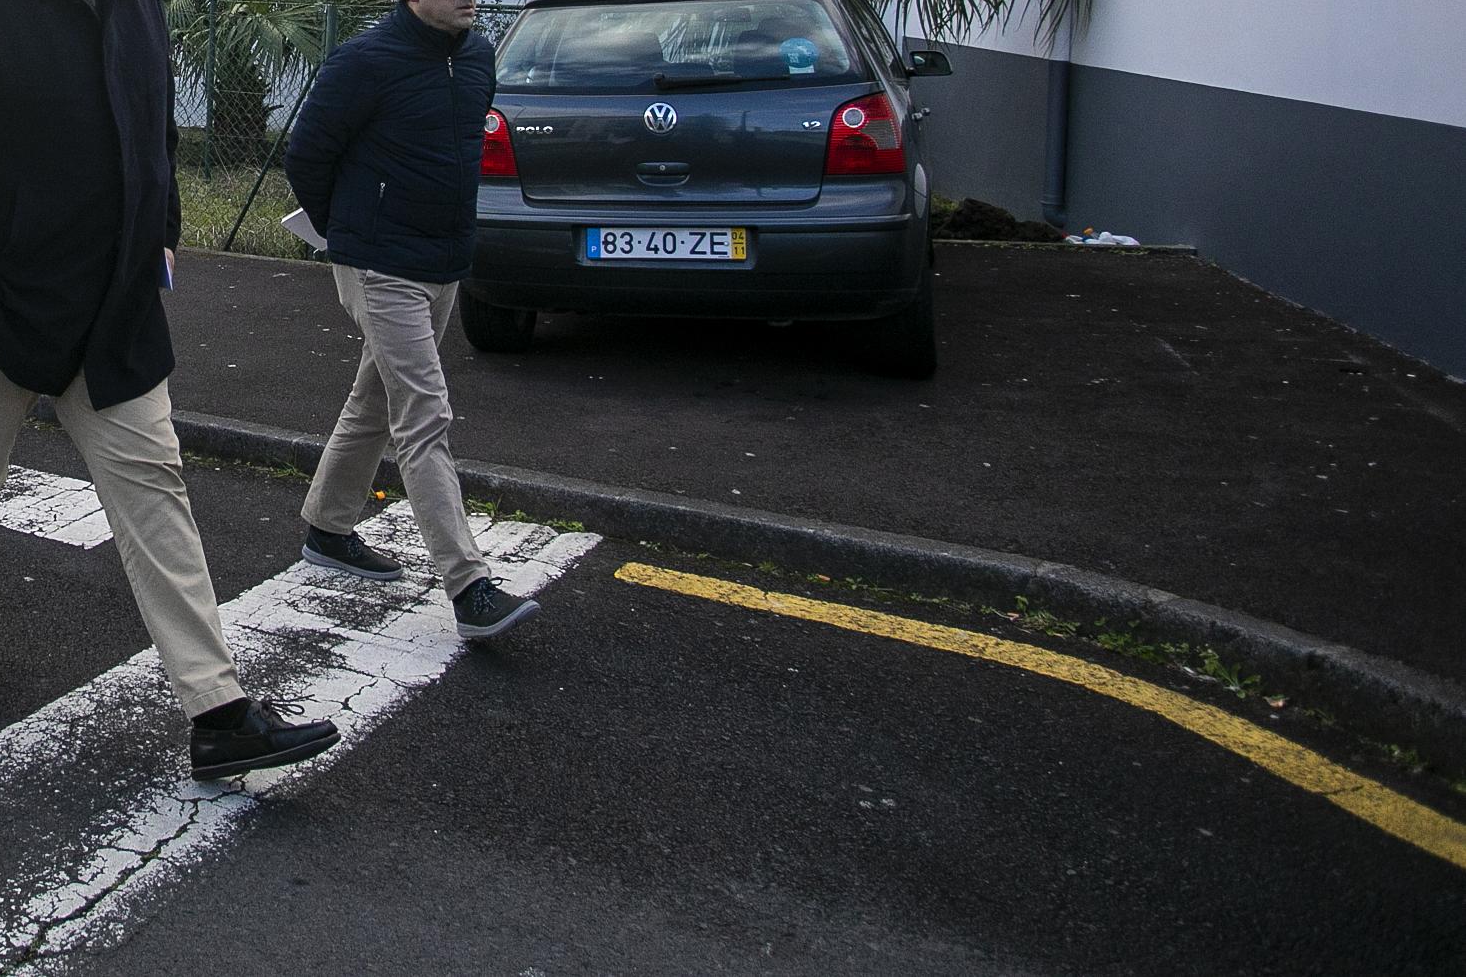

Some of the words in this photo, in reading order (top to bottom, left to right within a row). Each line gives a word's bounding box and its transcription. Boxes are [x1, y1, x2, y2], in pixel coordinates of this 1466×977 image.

[516, 125, 554, 135] POLO
[731, 231, 744, 240] 04
[591, 245, 598, 253] P
[734, 246, 745, 255] 11
